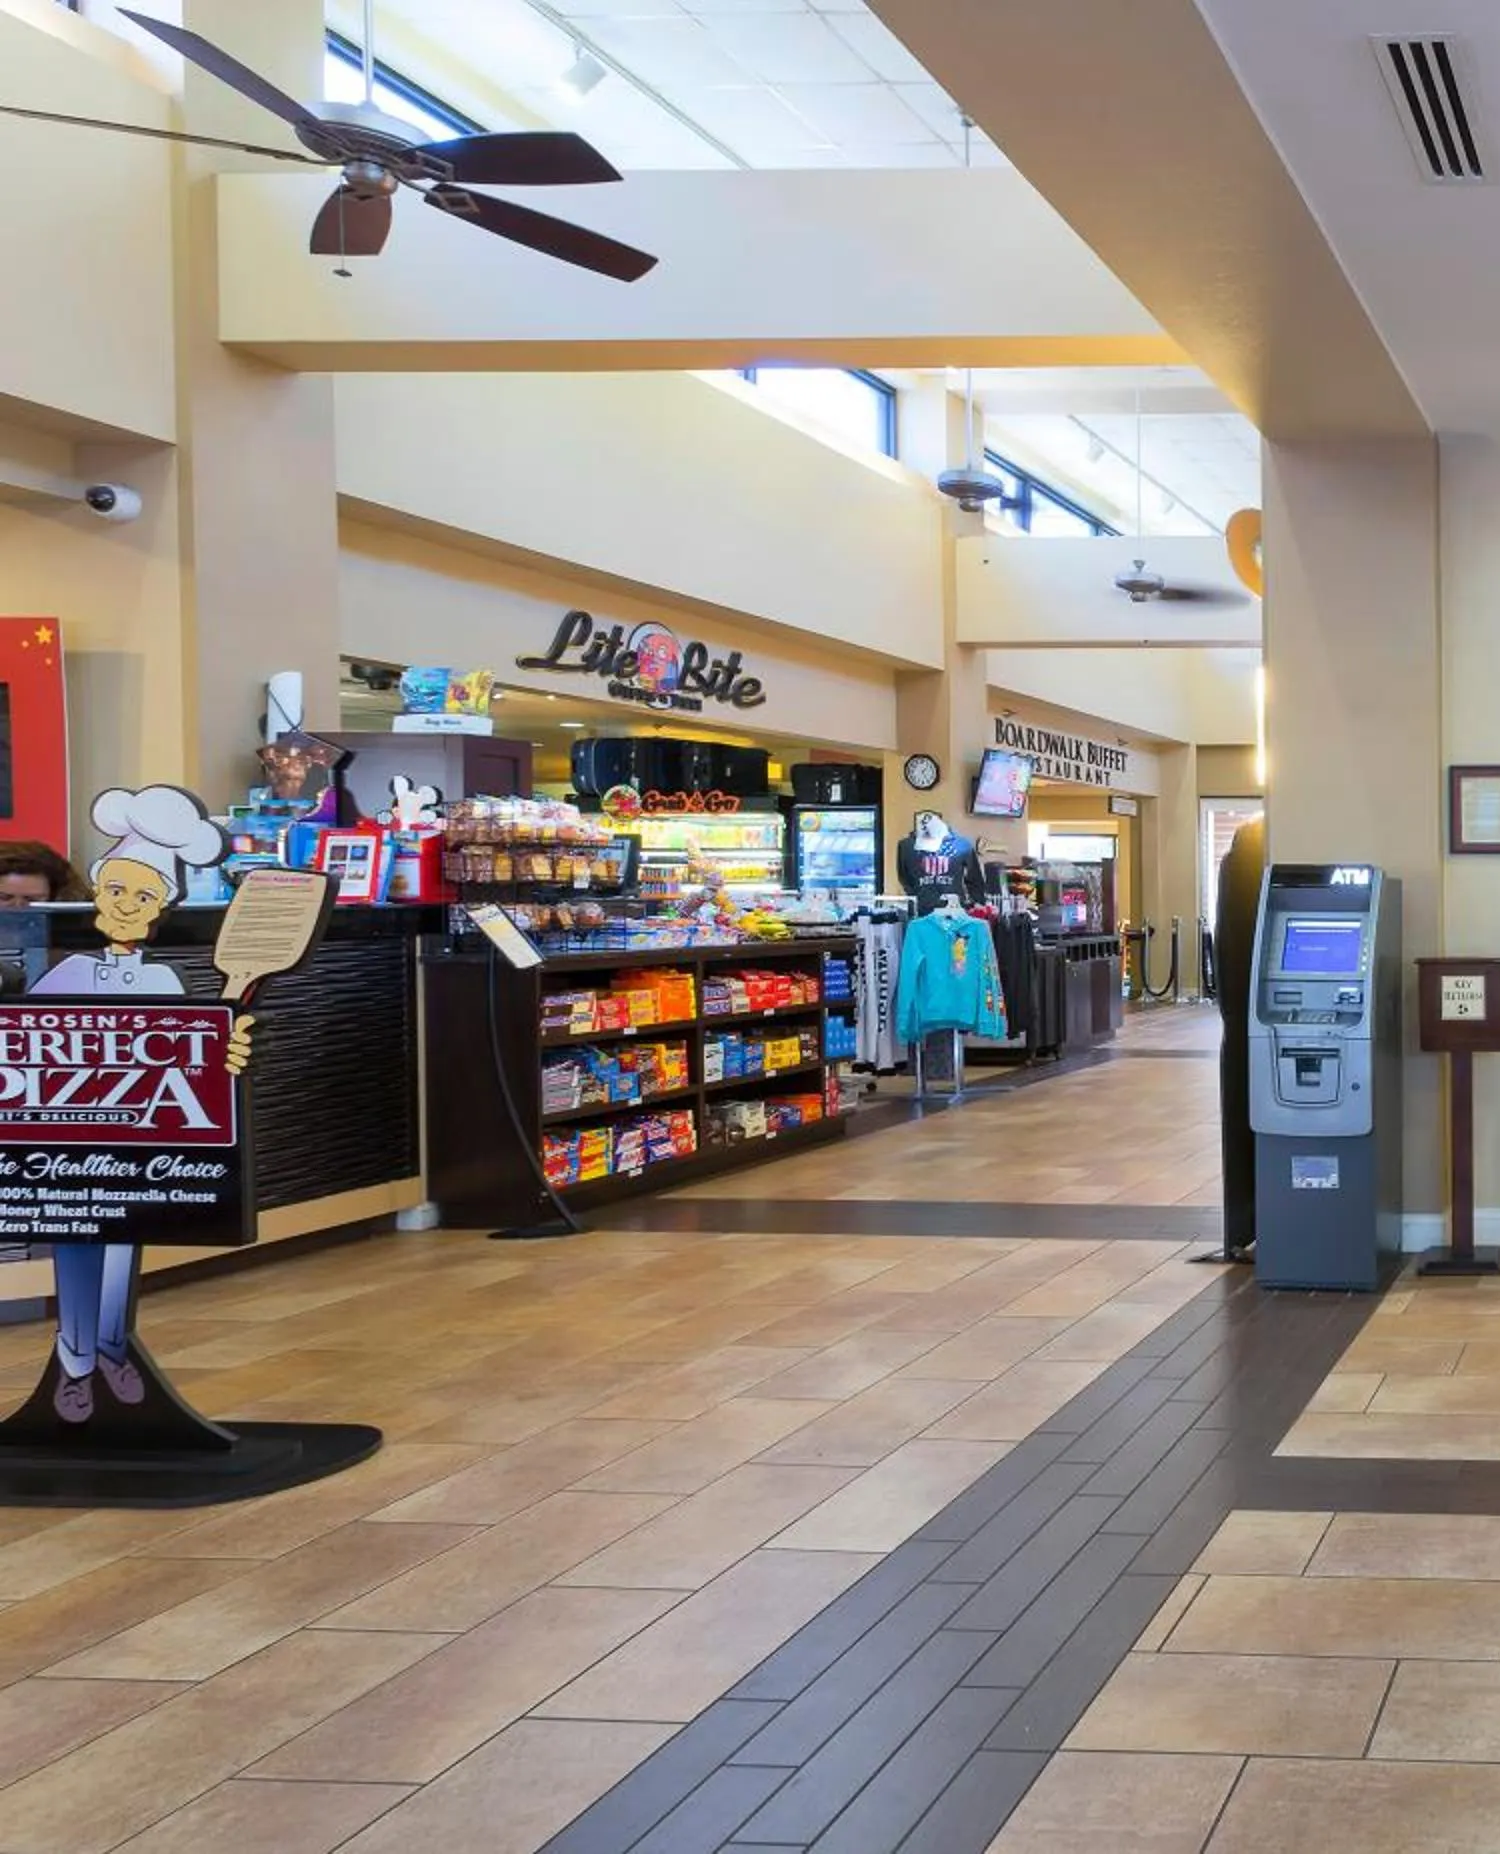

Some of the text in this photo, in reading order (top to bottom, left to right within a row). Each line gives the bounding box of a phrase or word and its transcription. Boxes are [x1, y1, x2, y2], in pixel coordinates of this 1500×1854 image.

[515, 610, 640, 678] Lite
[994, 718, 1128, 773] BOARDWALK BUFFET
[1010, 752, 1112, 786] STAURANT
[1330, 867, 1369, 885] ATM
[20, 1014, 148, 1029] ROSEN'S
[0, 1029, 219, 1067] ERFECT
[0, 1066, 222, 1129] PIZZA
[41, 1112, 129, 1122] DELICIOUS
[0, 1151, 228, 1181] he Healthier Choice
[37, 1187, 89, 1201] Natural
[91, 1187, 167, 1202] Mozzarella
[169, 1189, 217, 1203] Cheese
[43, 1203, 89, 1217] Wheat
[91, 1204, 126, 1218] Crust
[31, 1220, 69, 1233] Trans
[71, 1221, 100, 1234] Fats
